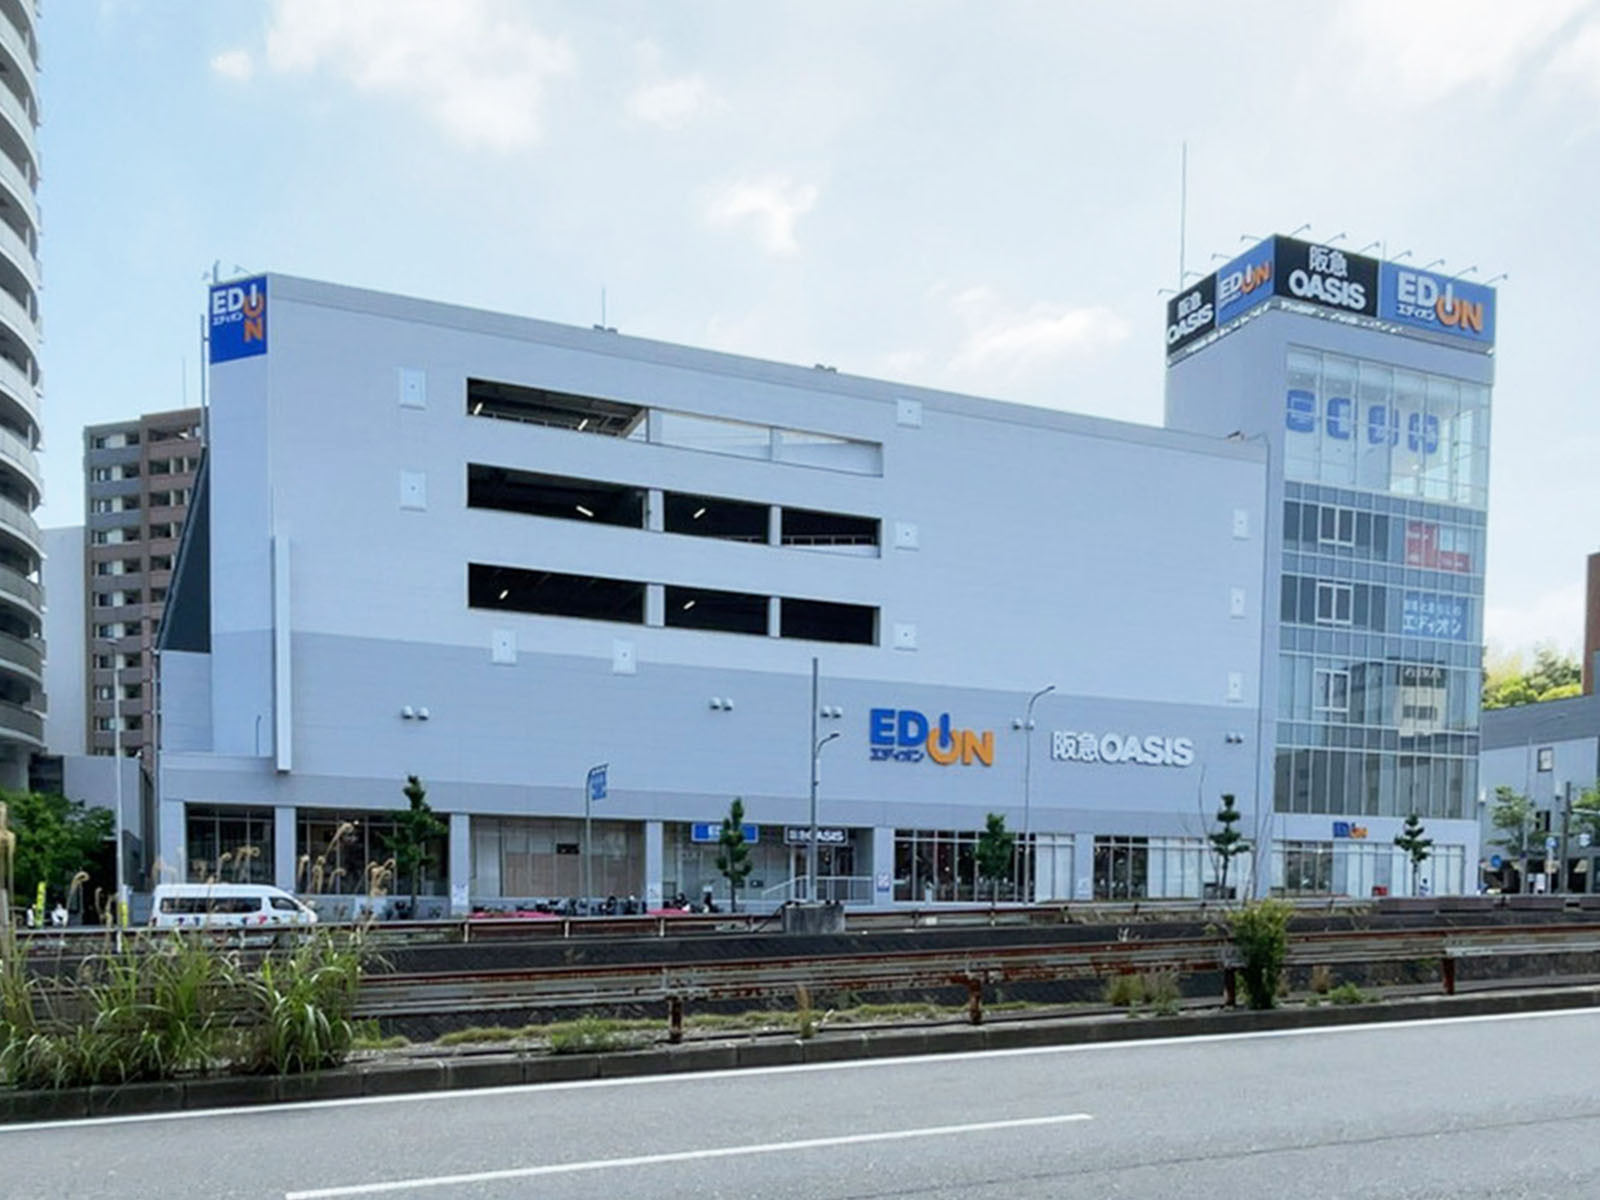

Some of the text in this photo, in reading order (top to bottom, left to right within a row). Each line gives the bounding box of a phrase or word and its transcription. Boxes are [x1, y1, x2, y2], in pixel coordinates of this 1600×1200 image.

[1288, 268, 1366, 311] OASIS
[1397, 271, 1484, 333] EDION
[869, 708, 994, 767] EDION
